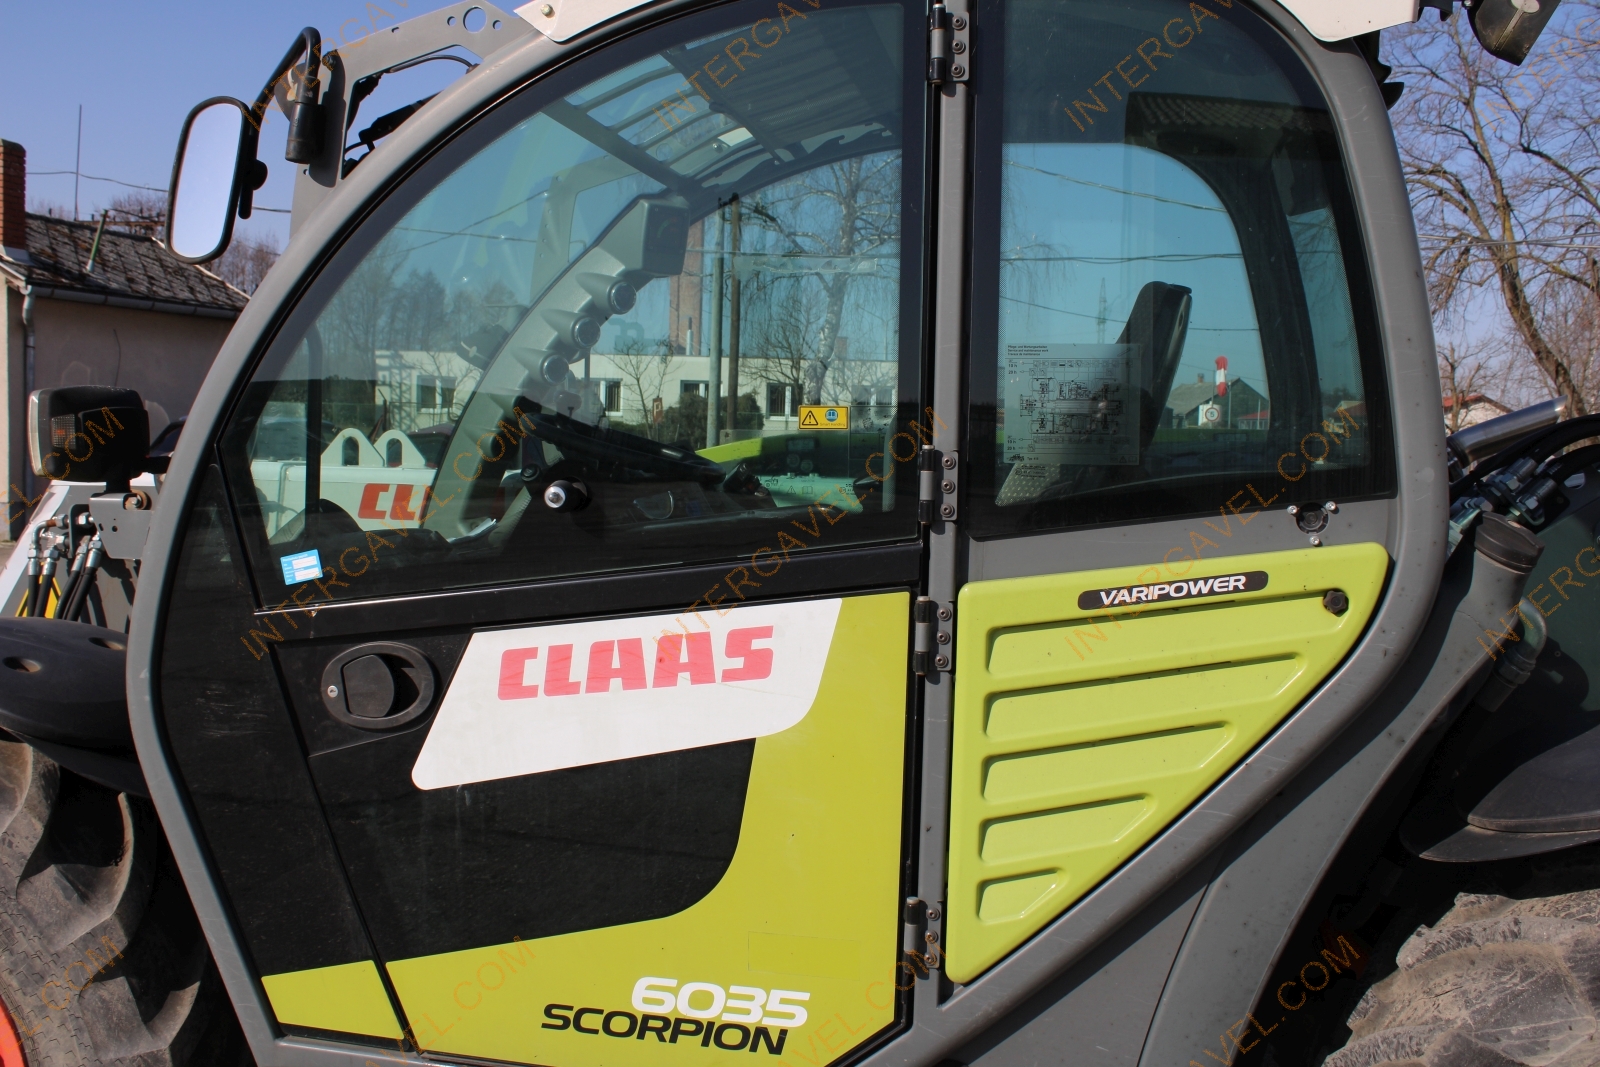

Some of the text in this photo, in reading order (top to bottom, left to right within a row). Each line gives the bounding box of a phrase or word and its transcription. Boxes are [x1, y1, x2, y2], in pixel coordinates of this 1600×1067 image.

[358, 483, 430, 521] CL
[1099, 574, 1246, 608] VARIPOWER
[498, 625, 774, 701] CLAAS
[631, 976, 811, 1028] 6035
[541, 1003, 788, 1056] SCORPION
